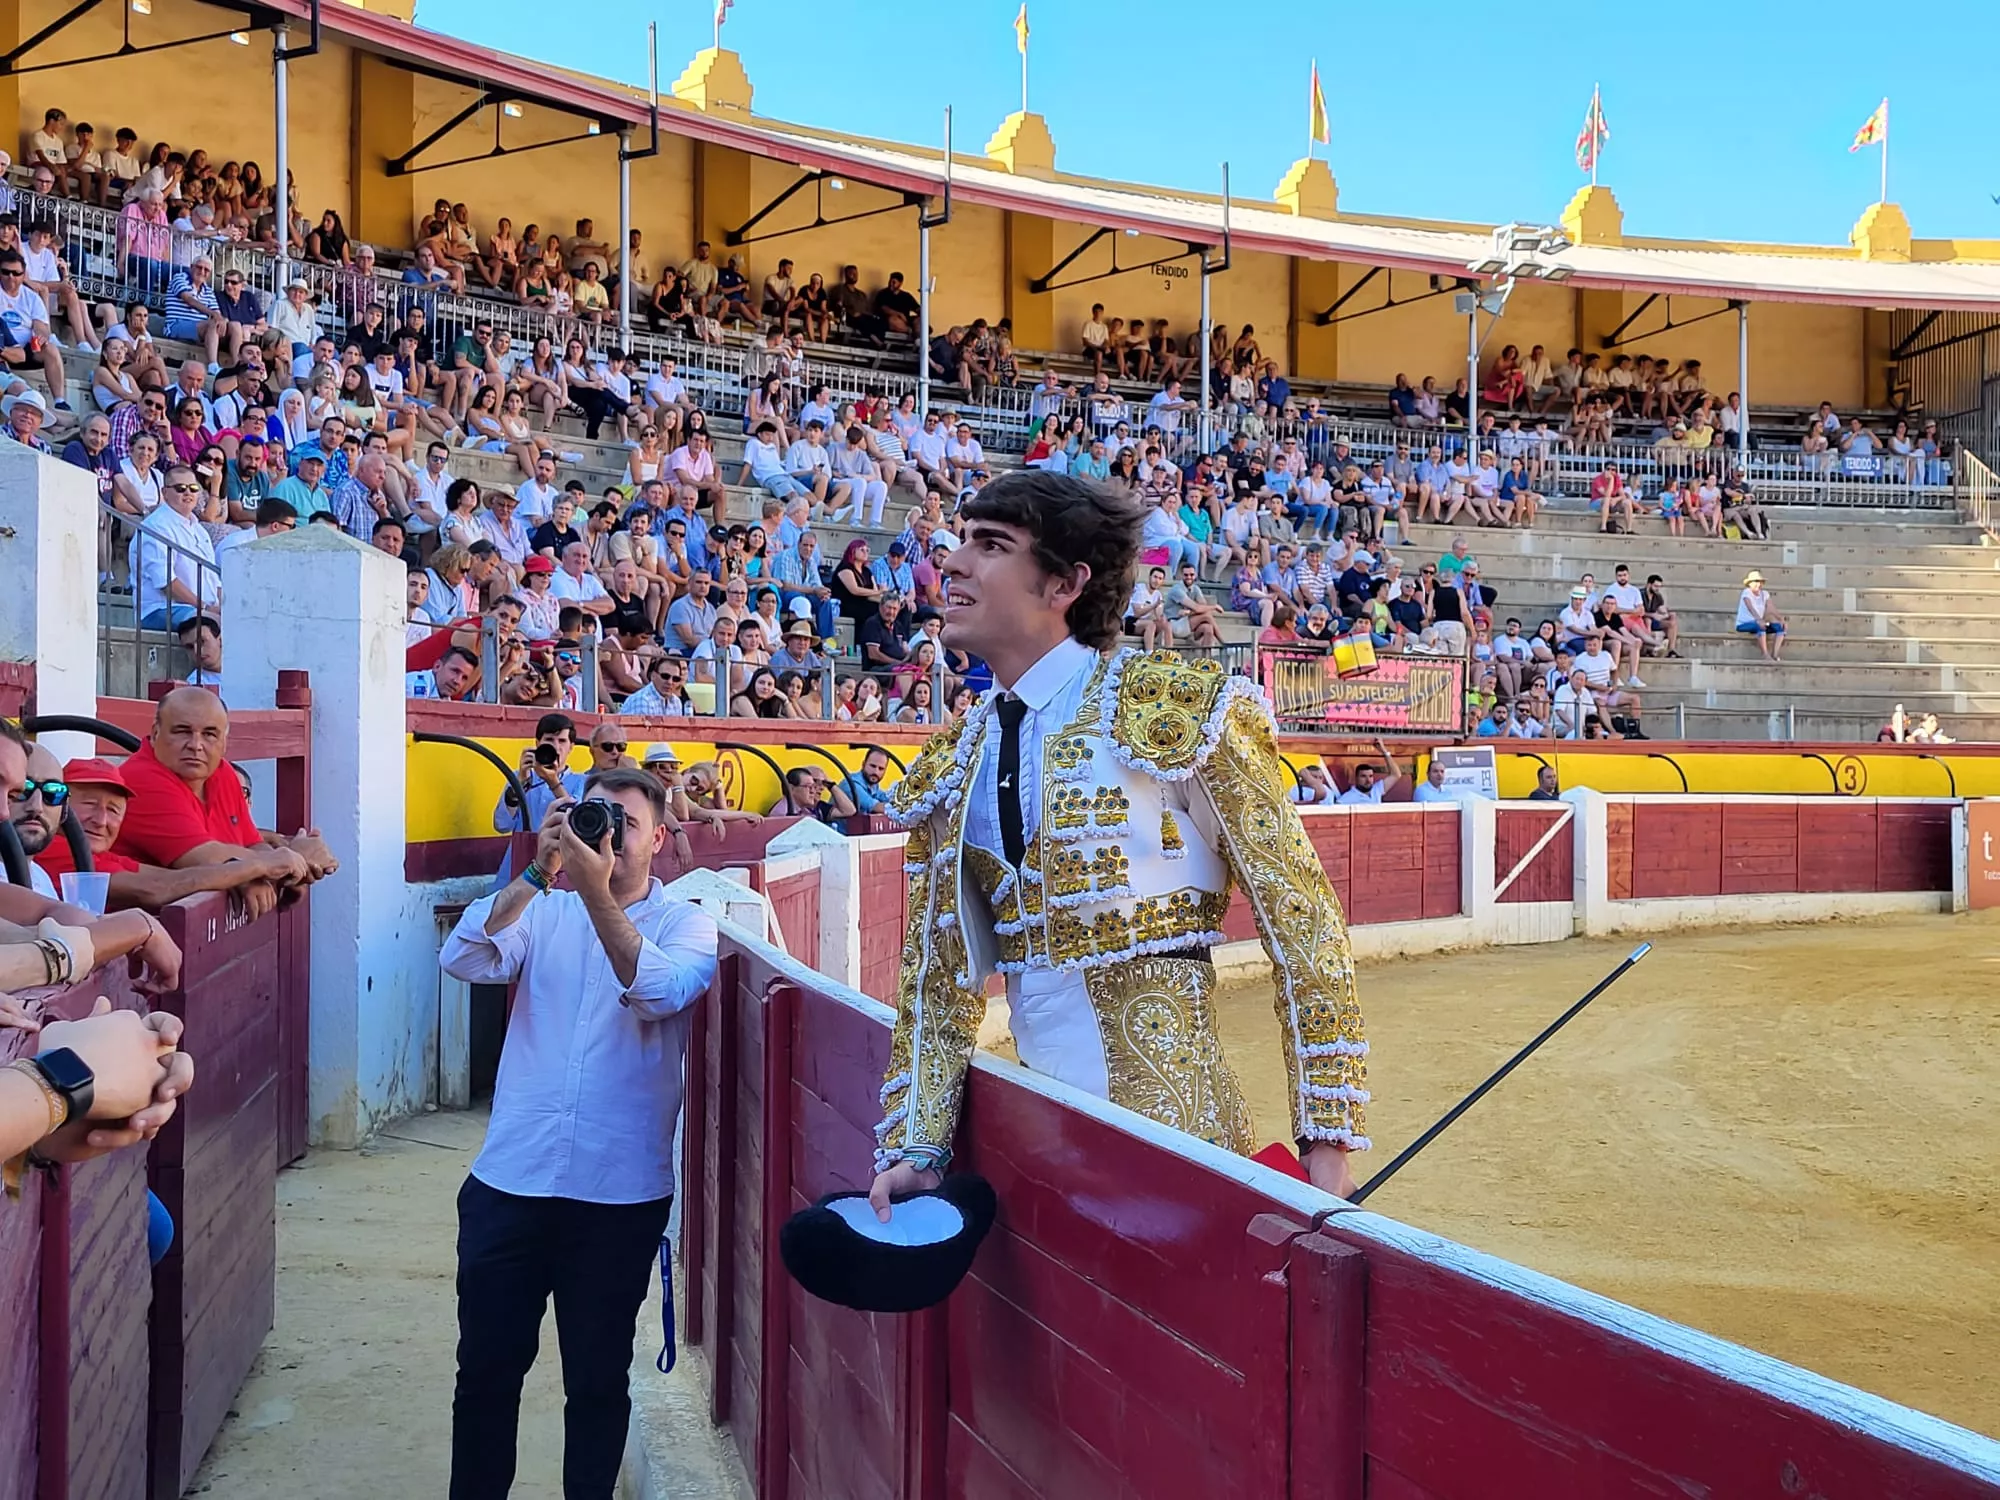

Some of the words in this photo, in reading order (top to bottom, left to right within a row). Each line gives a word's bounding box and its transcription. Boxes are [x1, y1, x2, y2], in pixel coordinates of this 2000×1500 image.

[1151, 264, 1189, 279] TENDIDO
[1164, 279, 1171, 291] 3
[1275, 661, 1323, 716] ASCASO
[1329, 684, 1344, 700] SU
[1346, 685, 1405, 702] PASTELERÍA
[1410, 669, 1452, 721] ASCASO
[722, 760, 735, 807] 2
[1845, 765, 1857, 790] 3
